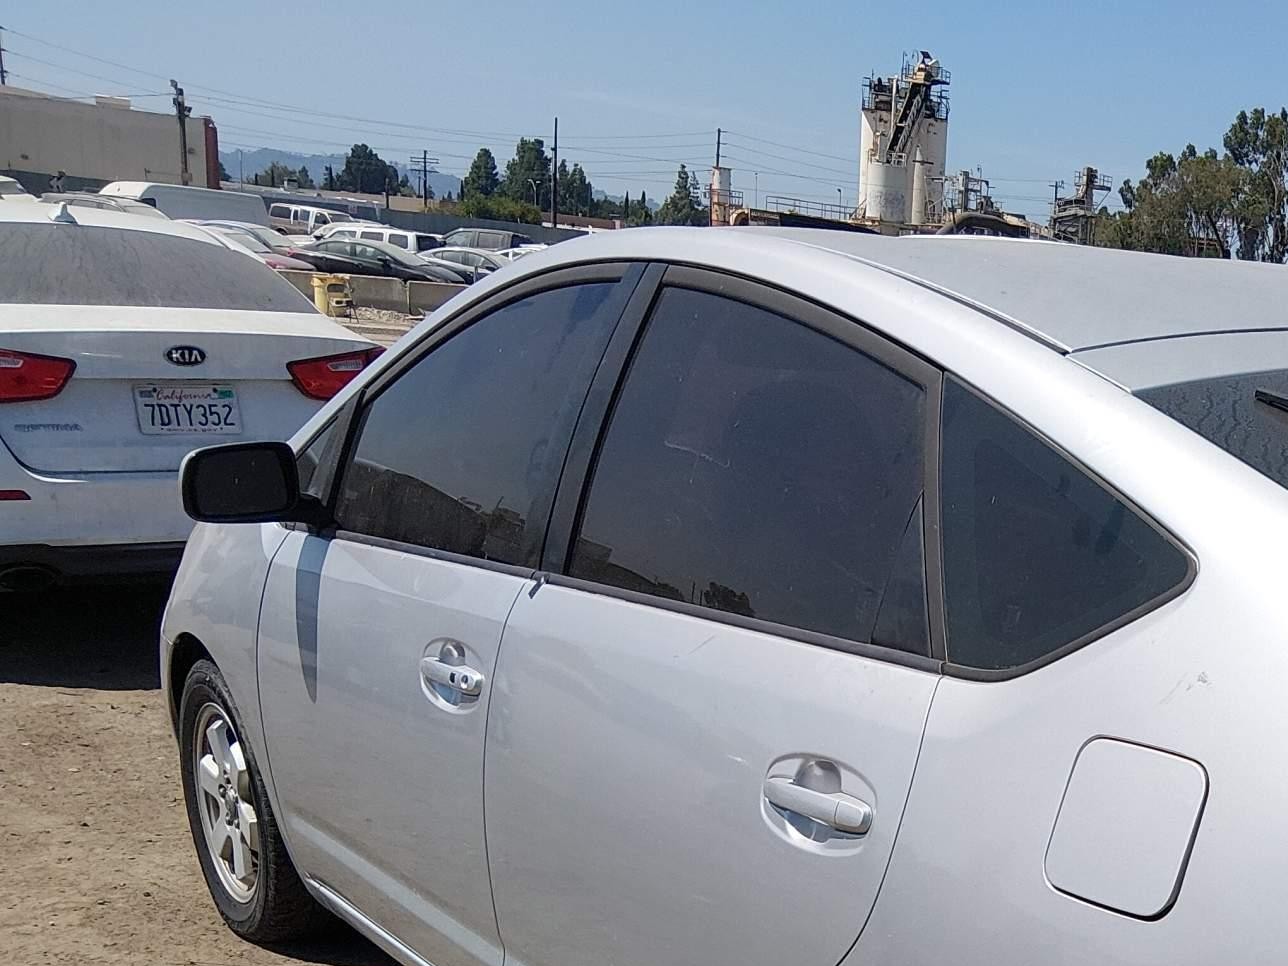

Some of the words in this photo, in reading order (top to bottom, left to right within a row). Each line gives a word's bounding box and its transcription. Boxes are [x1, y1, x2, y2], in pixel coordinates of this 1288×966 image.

[171, 349, 201, 362] KIA
[156, 388, 213, 403] California
[144, 403, 236, 427] 7DTY352
